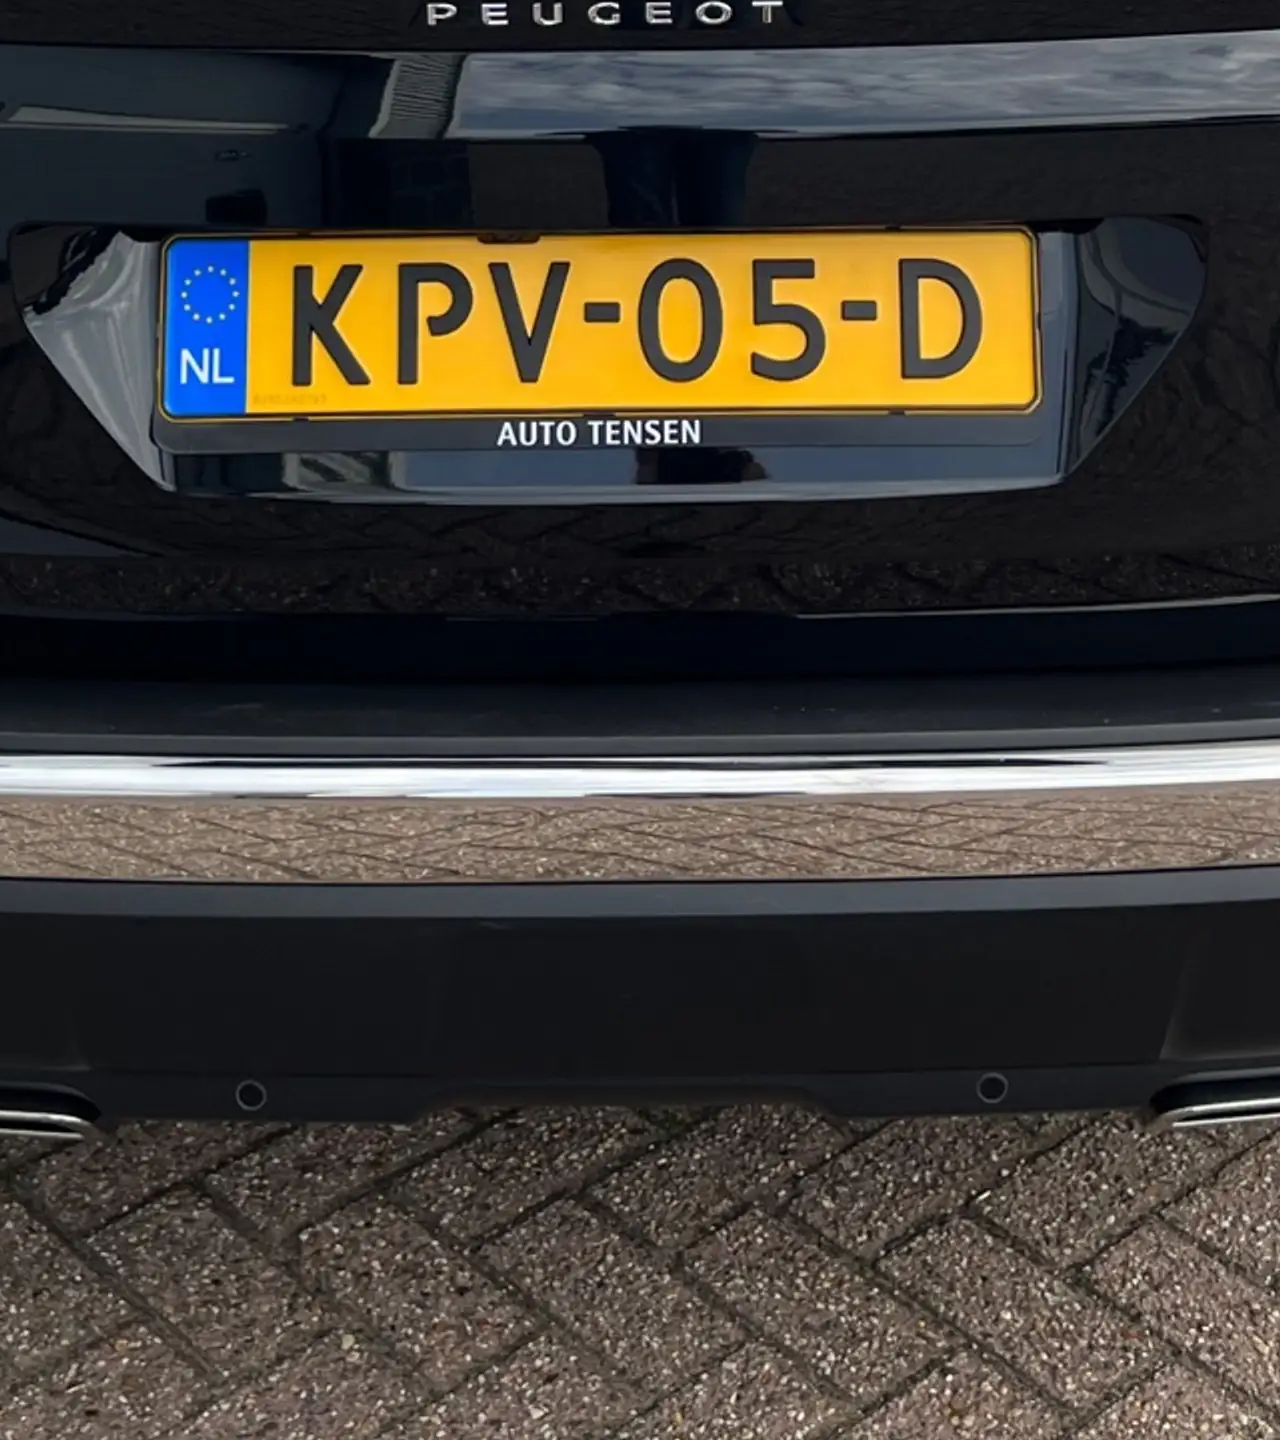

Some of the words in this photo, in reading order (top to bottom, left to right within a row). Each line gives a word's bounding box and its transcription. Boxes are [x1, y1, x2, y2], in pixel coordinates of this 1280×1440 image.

[426, 0, 784, 26] PEUGEOT
[291, 257, 984, 387] KPV-05-D
[179, 347, 236, 385] NL
[497, 420, 578, 447] AUTO
[587, 419, 701, 446] TENSEN
